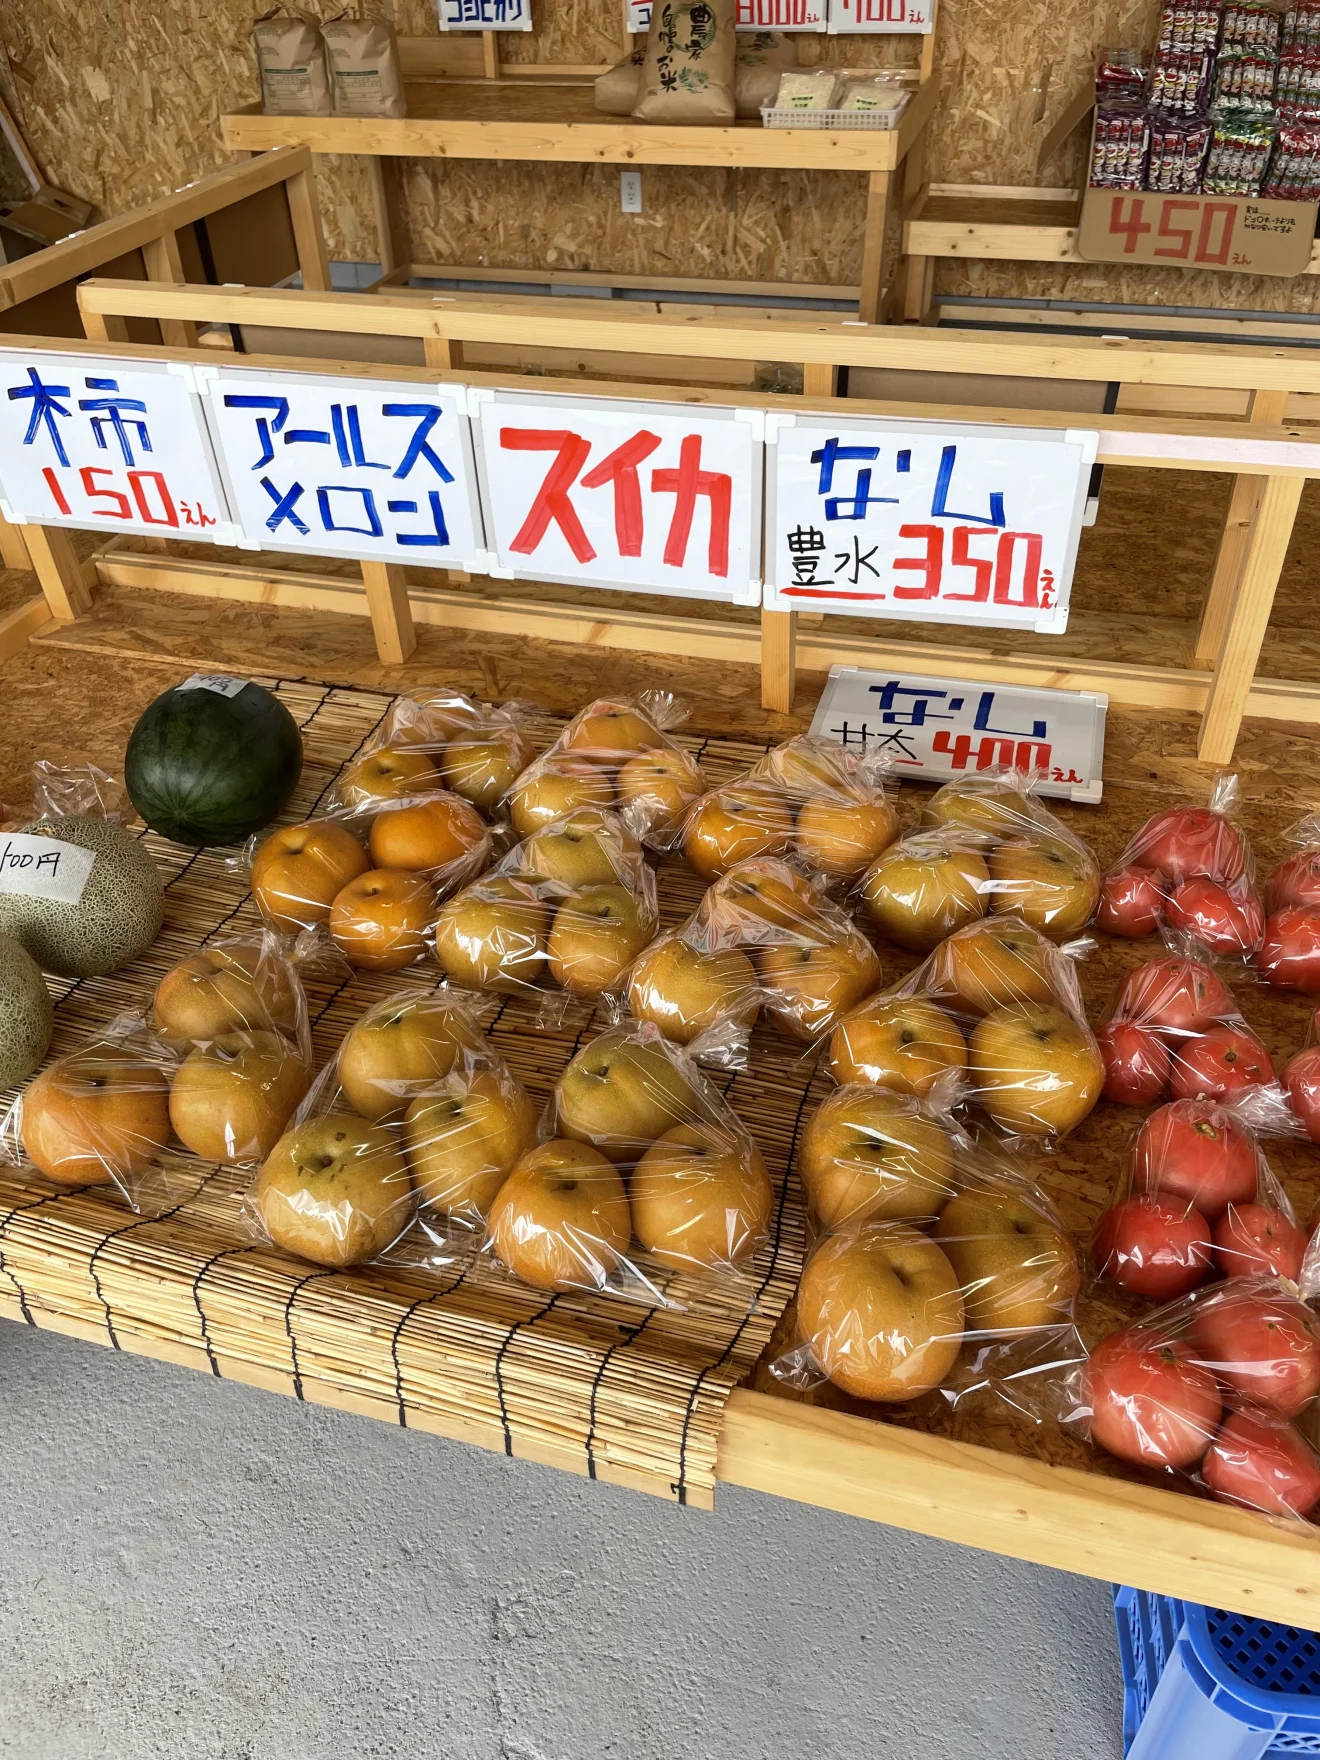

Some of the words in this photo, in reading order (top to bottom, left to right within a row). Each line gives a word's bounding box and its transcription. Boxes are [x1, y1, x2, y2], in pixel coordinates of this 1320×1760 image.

[1109, 196, 1252, 266] 450えん
[8, 367, 153, 467] 柿
[224, 394, 456, 483] アールス
[42, 466, 217, 528] 150えん
[260, 475, 451, 546] メロン
[500, 427, 732, 578] スイカ
[811, 437, 1007, 528] なし
[787, 524, 881, 586] 豊水
[868, 681, 1047, 739] なし
